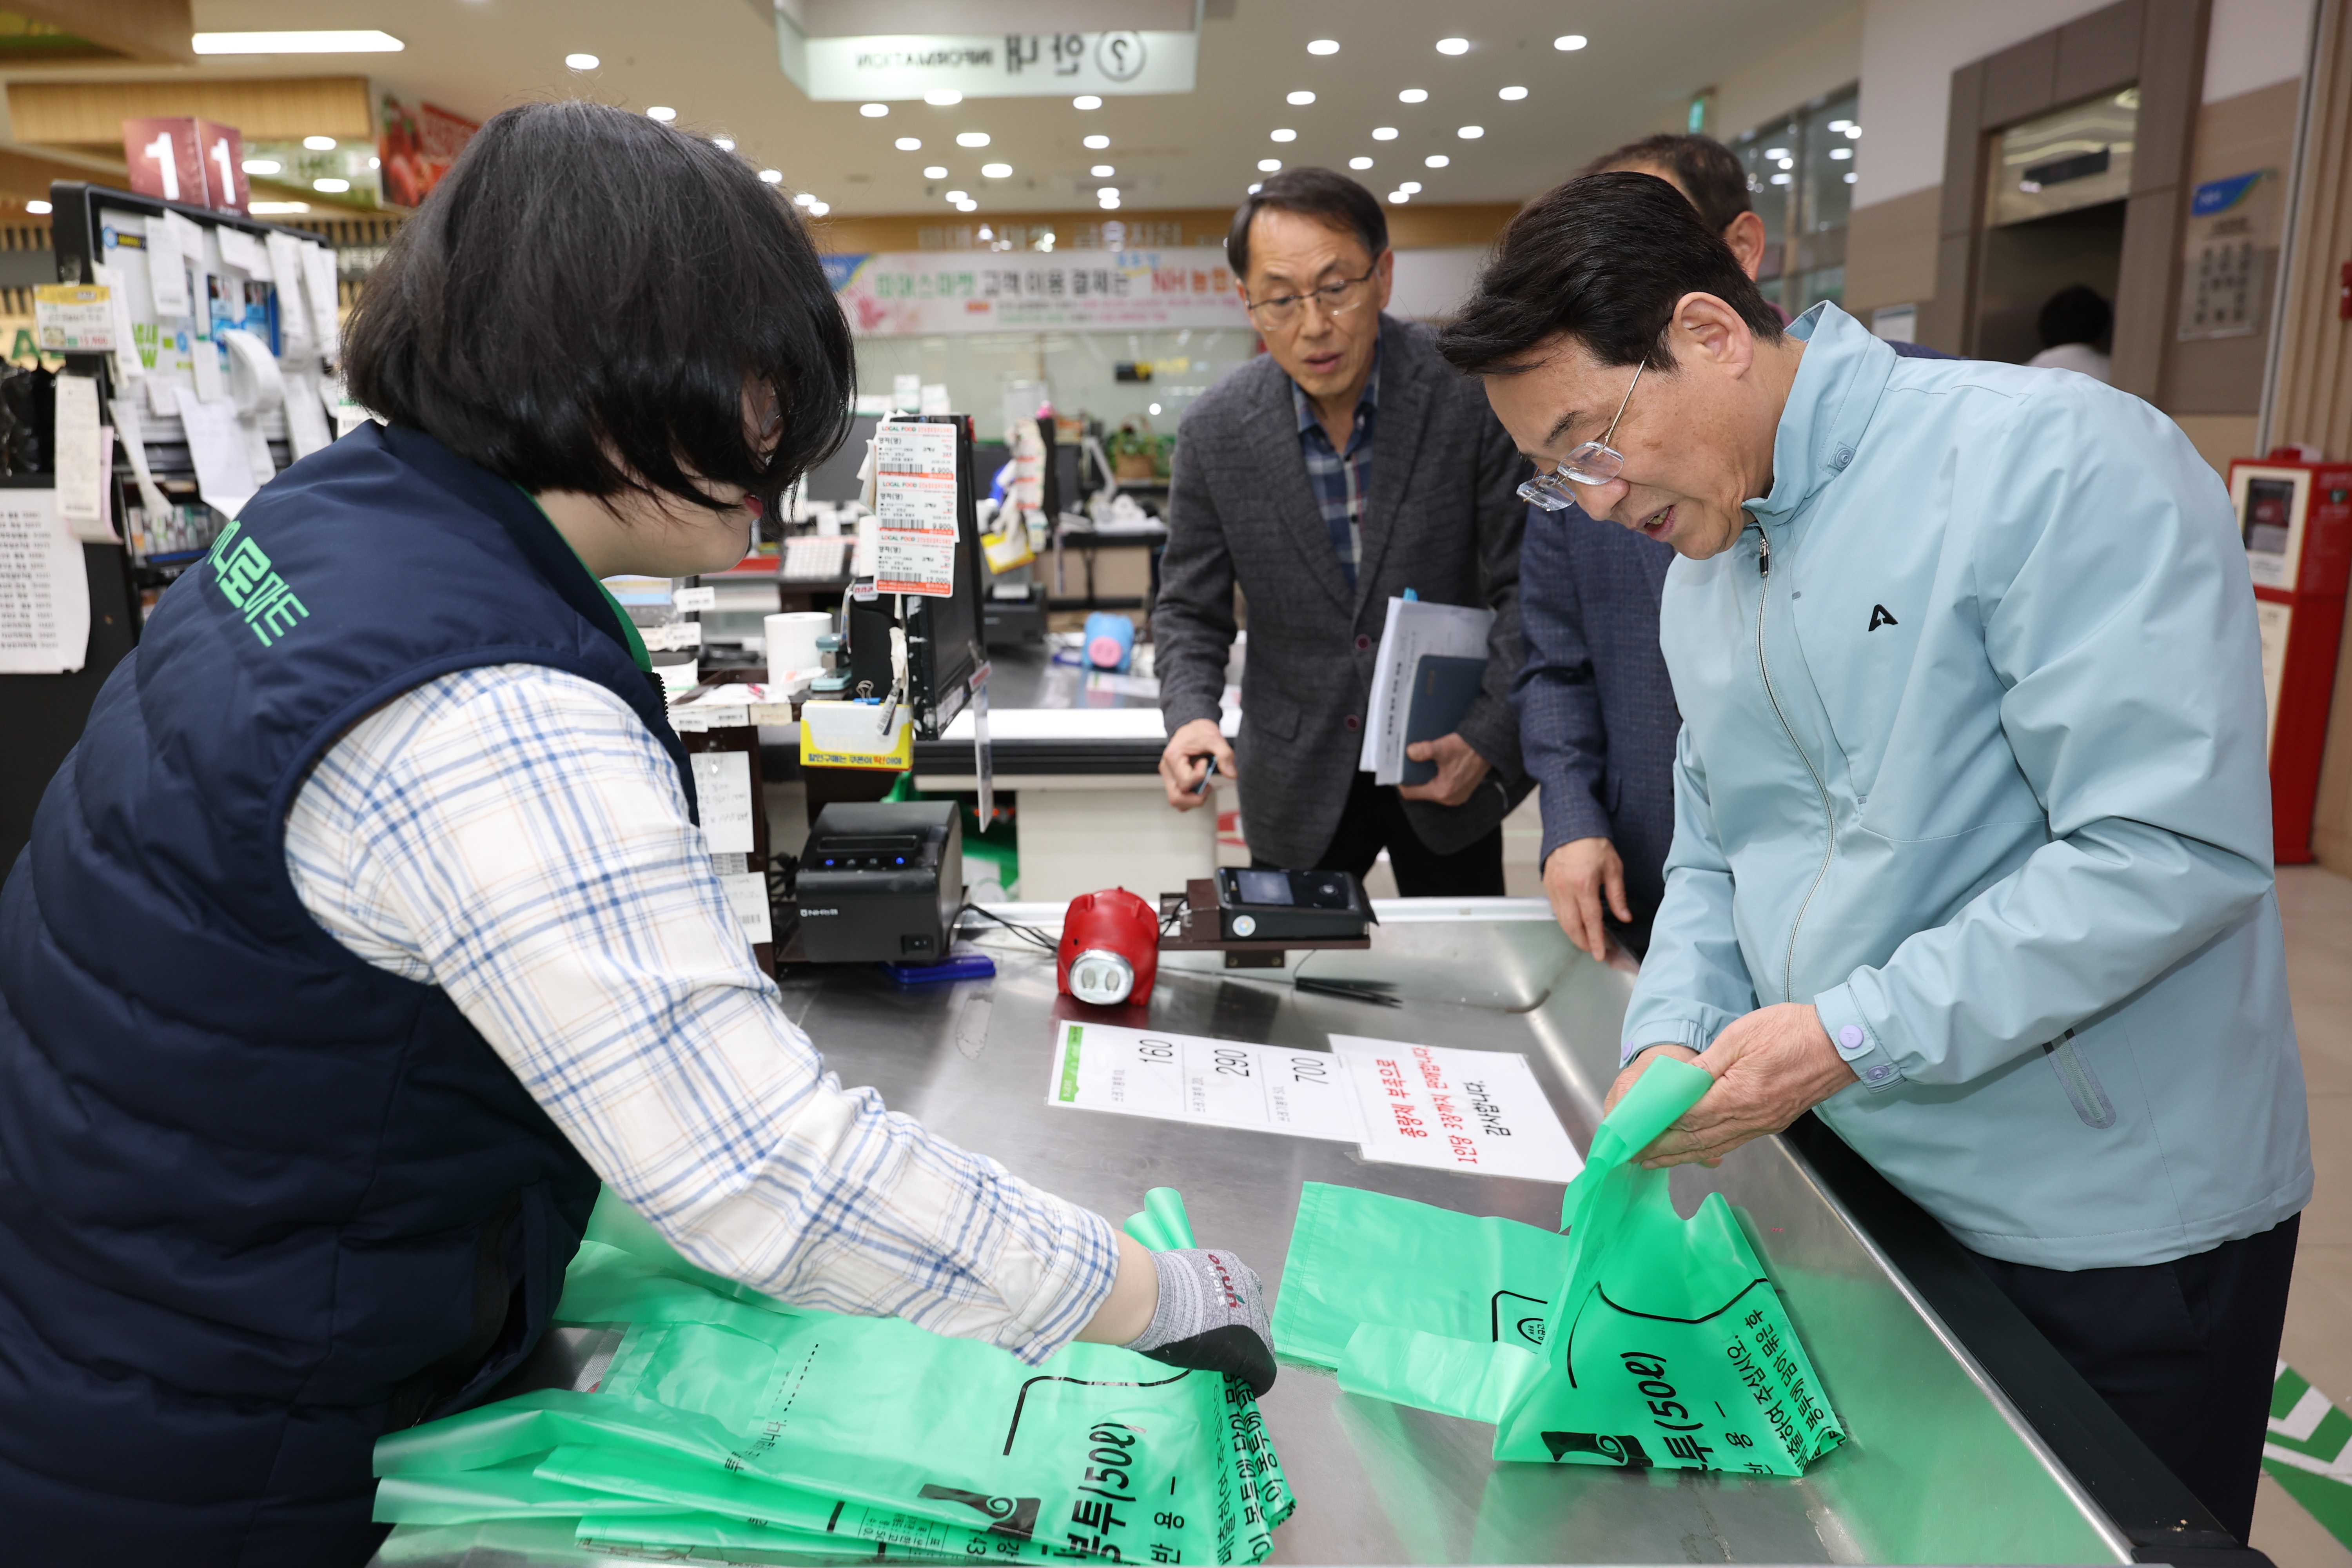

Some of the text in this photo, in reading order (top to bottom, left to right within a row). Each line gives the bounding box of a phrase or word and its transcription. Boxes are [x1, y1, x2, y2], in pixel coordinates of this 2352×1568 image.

[144, 132, 180, 201] 1
[211, 137, 236, 205] 1
[1139, 1039, 1173, 1065] 160
[1214, 1049, 1251, 1078] 290
[1291, 1057, 1330, 1085] 700
[1376, 1059, 1428, 1138] 종량제 부족으로
[1411, 1046, 1478, 1164] 1인당 3장까지 판매합니다.
[1464, 1081, 1512, 1136] 감사합니다.
[1727, 1334, 1773, 1405] 주십시오.
[1744, 1309, 1824, 1432] 봉투에 담아 묶은 후
[1244, 1411, 1278, 1477] 봉투에
[1261, 1479, 1283, 1502] 이
